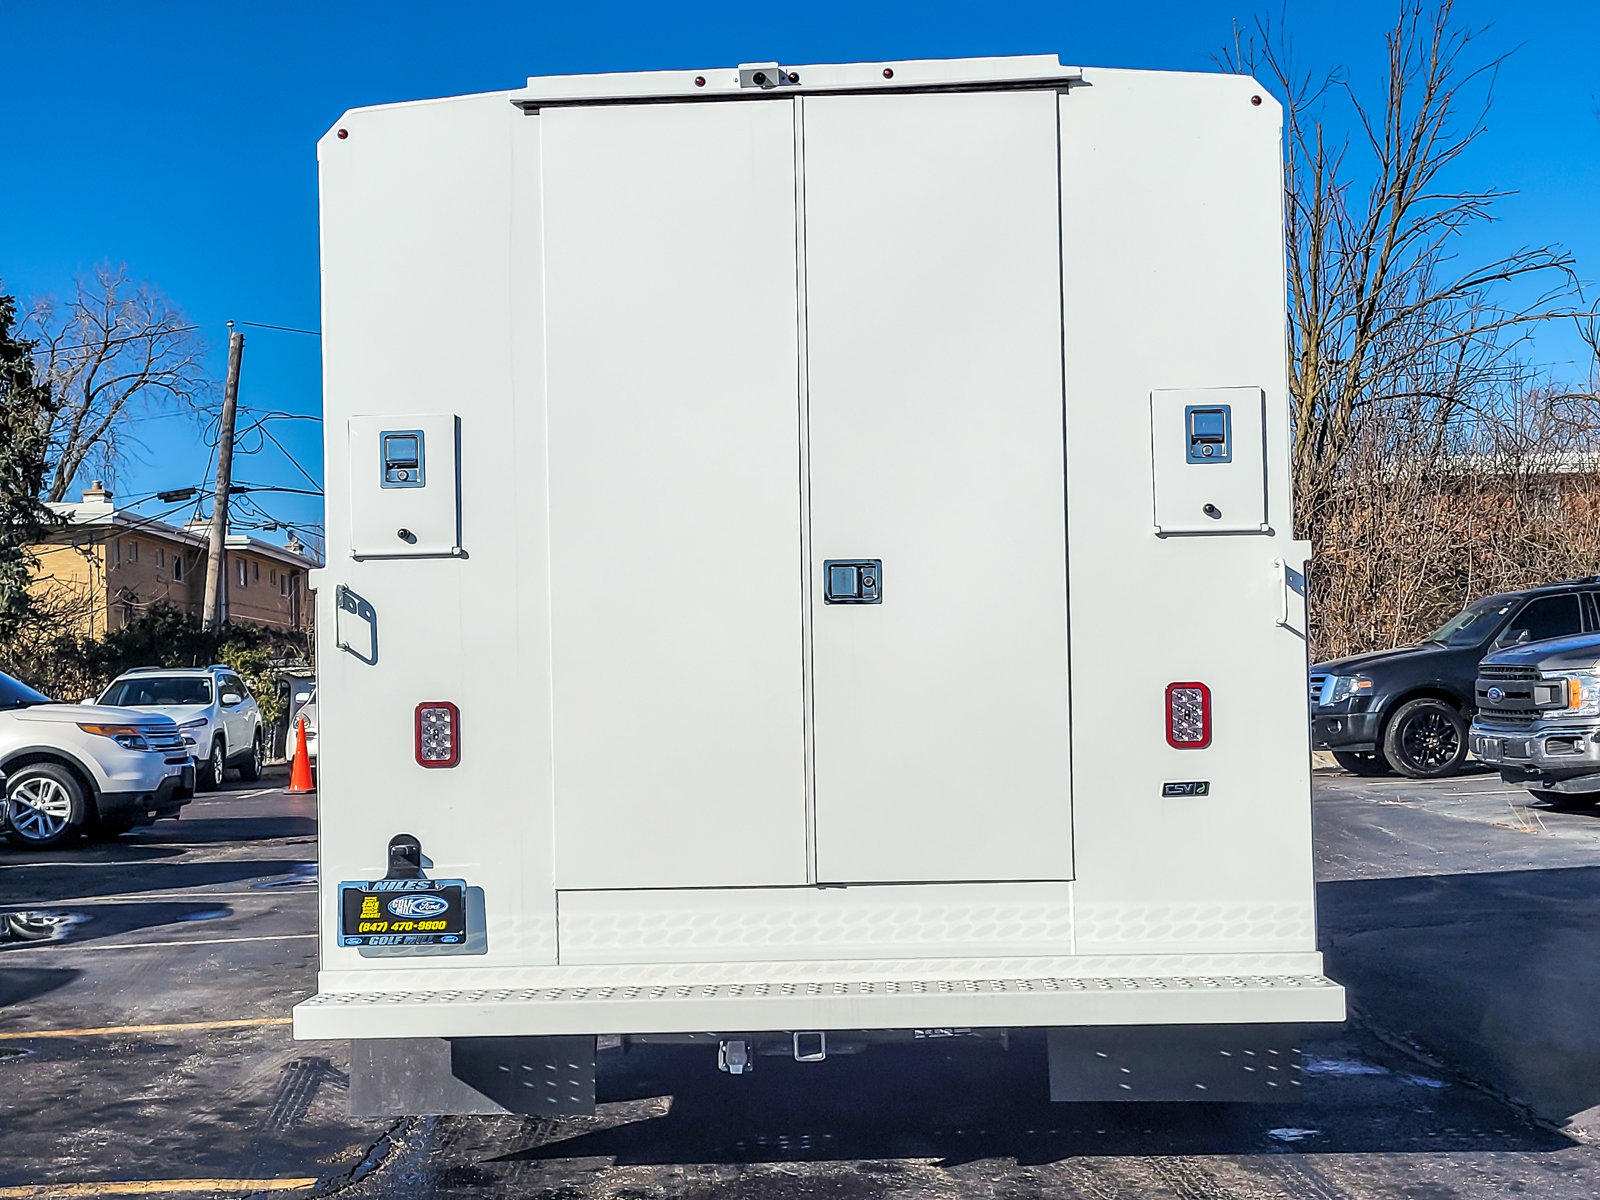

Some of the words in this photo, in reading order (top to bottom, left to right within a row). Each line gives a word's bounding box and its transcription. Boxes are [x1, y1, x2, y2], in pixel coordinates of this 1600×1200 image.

[371, 881, 431, 891] NILES
[359, 922, 388, 932] (847)
[391, 921, 447, 931] 470-9800
[368, 936, 402, 946] GOLF
[403, 935, 434, 945] MILL
